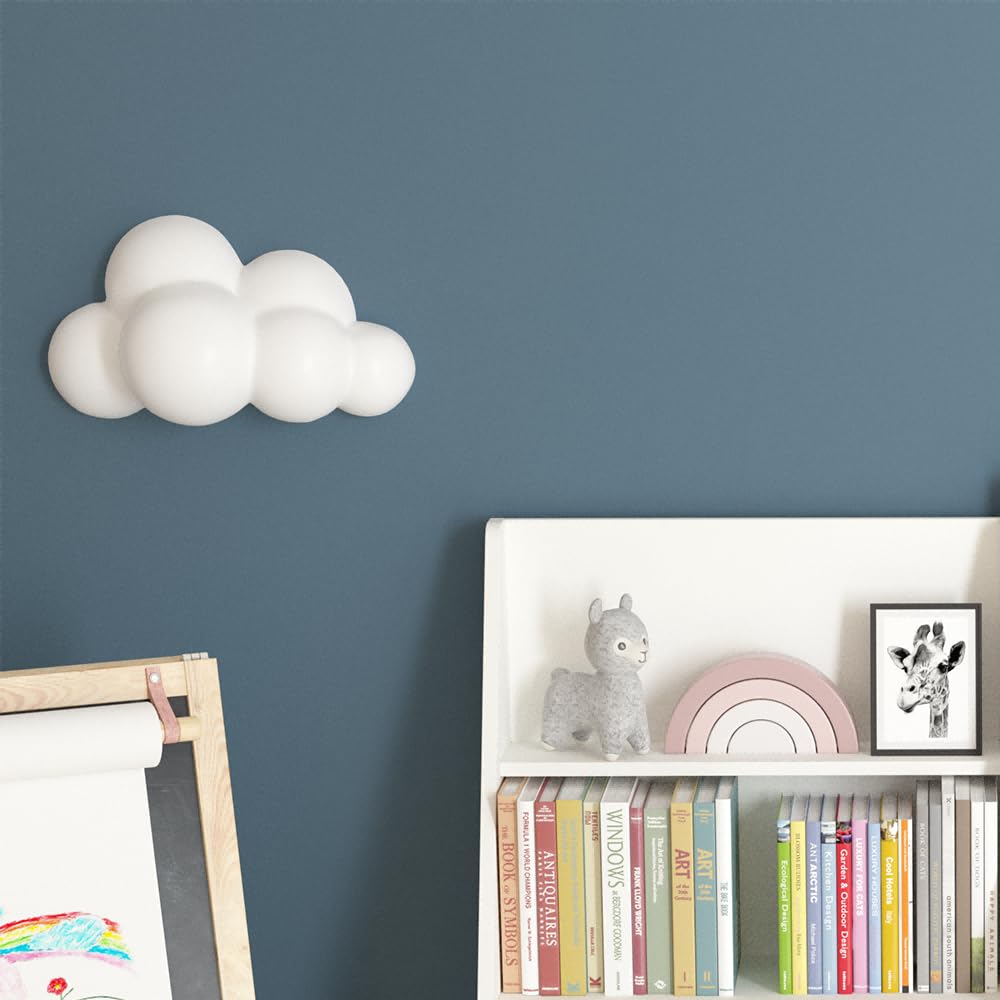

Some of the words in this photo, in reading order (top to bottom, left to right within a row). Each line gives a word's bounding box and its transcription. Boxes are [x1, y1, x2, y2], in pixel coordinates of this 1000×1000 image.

[502, 842, 516, 882] BOOK
[606, 809, 625, 888] WINDOWS
[674, 849, 690, 879] ART
[697, 848, 712, 880] ART
[840, 849, 848, 880] Garden
[780, 860, 788, 901] Ecological
[824, 850, 833, 890] Kitchen
[886, 857, 894, 876] Cool
[542, 851, 557, 946] ANTIQUAIRES
[886, 878, 894, 904] Hotels
[780, 904, 789, 932] Design
[824, 896, 834, 930] Design
[503, 897, 518, 968] SYMBOLS
[613, 928, 622, 960] GOODMAN
[840, 931, 848, 959] Design
